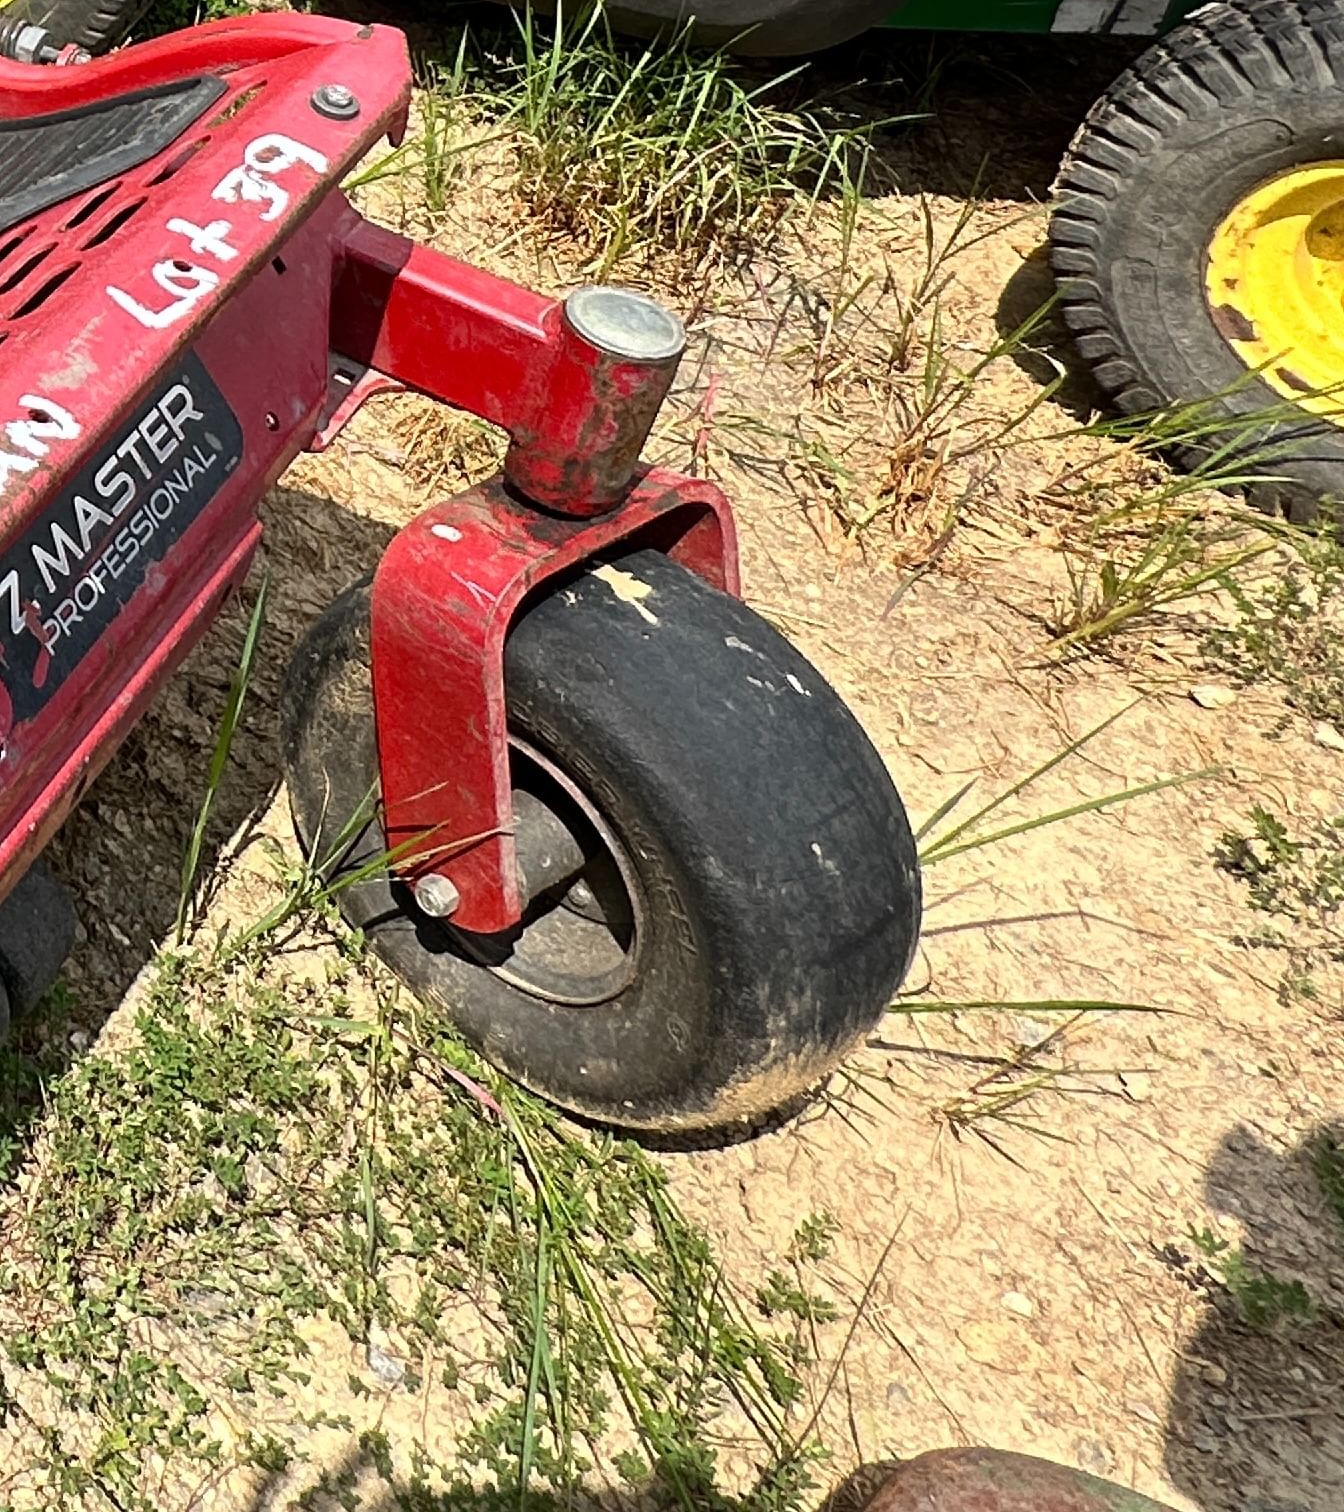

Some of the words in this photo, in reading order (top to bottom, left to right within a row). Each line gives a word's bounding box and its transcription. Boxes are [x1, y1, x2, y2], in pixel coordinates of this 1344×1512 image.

[106, 216, 239, 329] Lot
[212, 132, 330, 222] 39
[31, 383, 204, 594] MASTER
[43, 444, 218, 656] PROFESSIONAL
